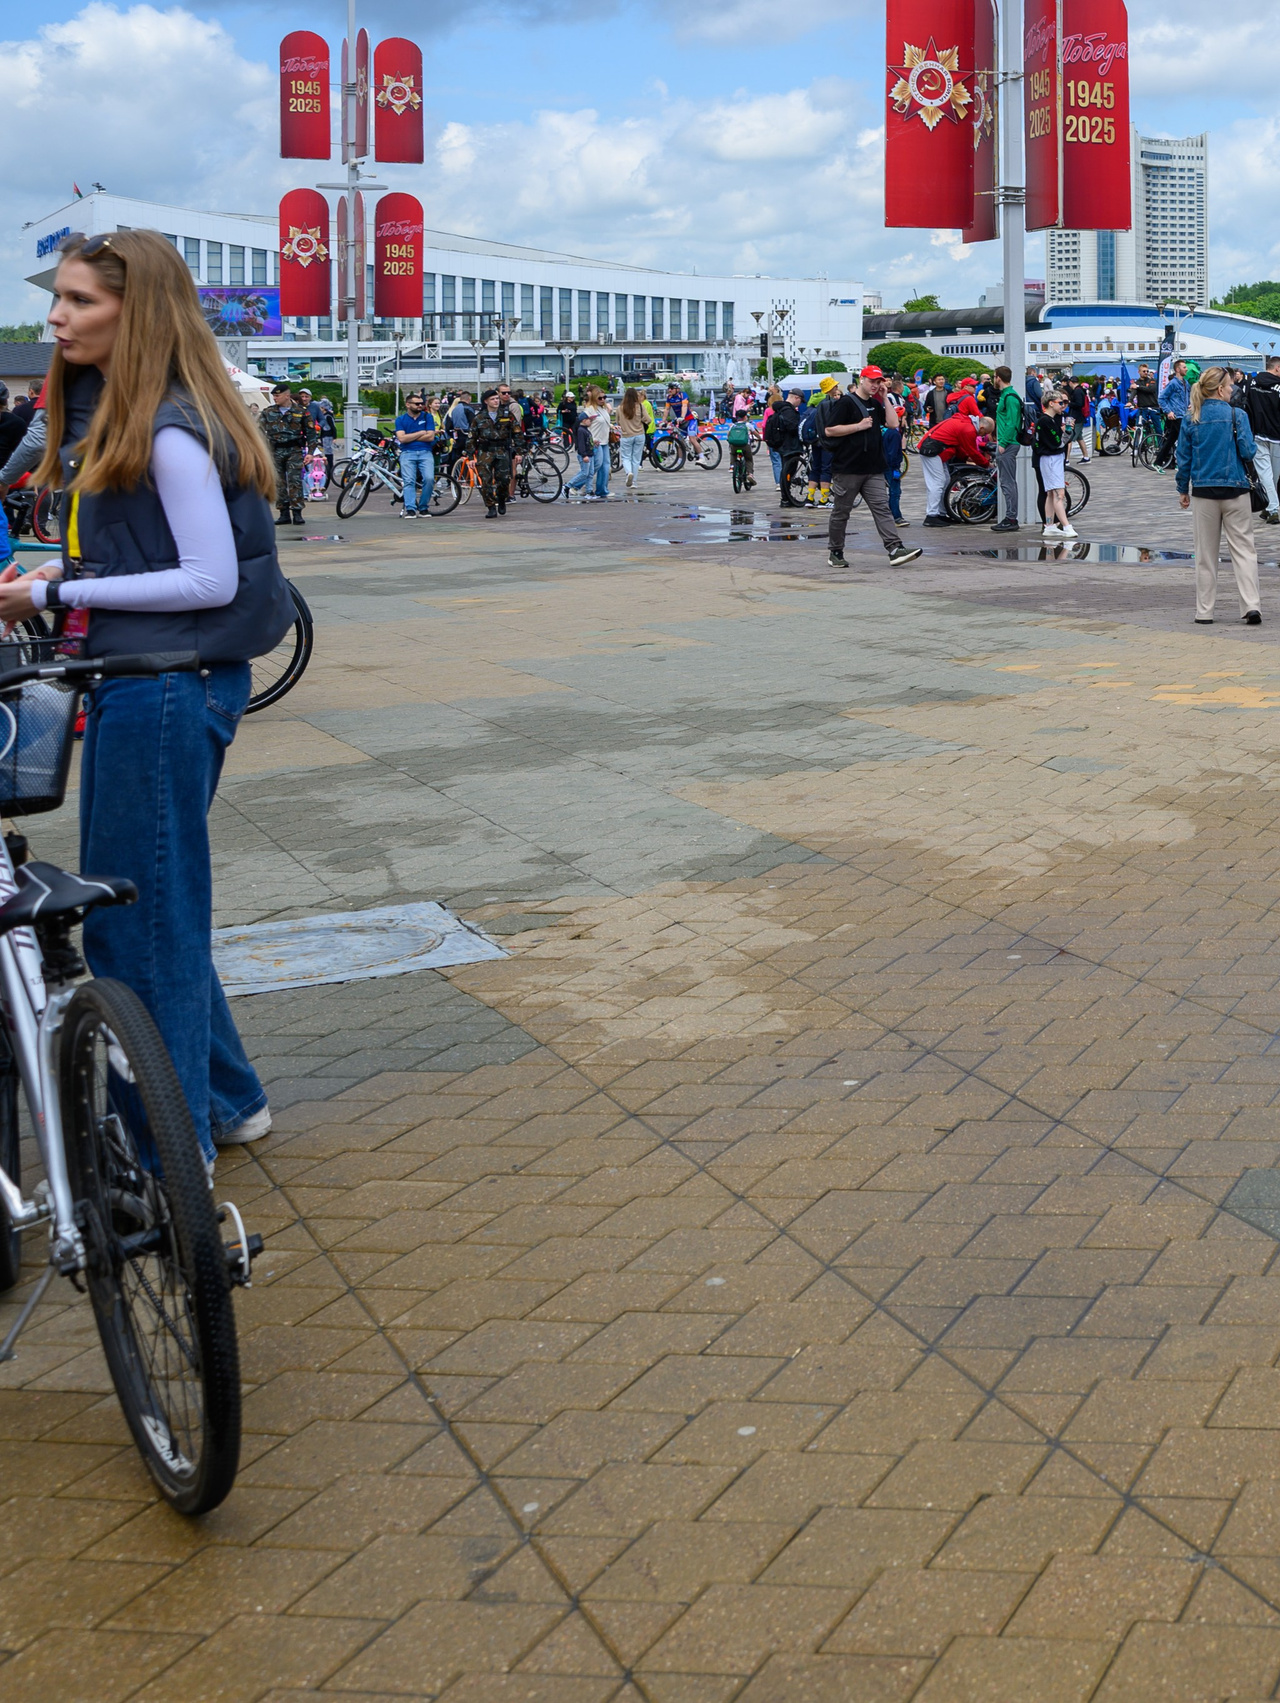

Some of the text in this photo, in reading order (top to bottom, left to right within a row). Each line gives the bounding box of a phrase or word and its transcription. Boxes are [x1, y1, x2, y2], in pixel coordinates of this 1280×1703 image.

[1061, 32, 1127, 76] Победа
[290, 80, 321, 95] 1945
[1030, 68, 1051, 101] 1945
[1067, 80, 1115, 109] 1945
[289, 98, 321, 113] 2025
[1029, 106, 1051, 139] 2025
[1065, 115, 1116, 144] 2025
[385, 244, 415, 258] 1945
[383, 261, 415, 276] 2025
